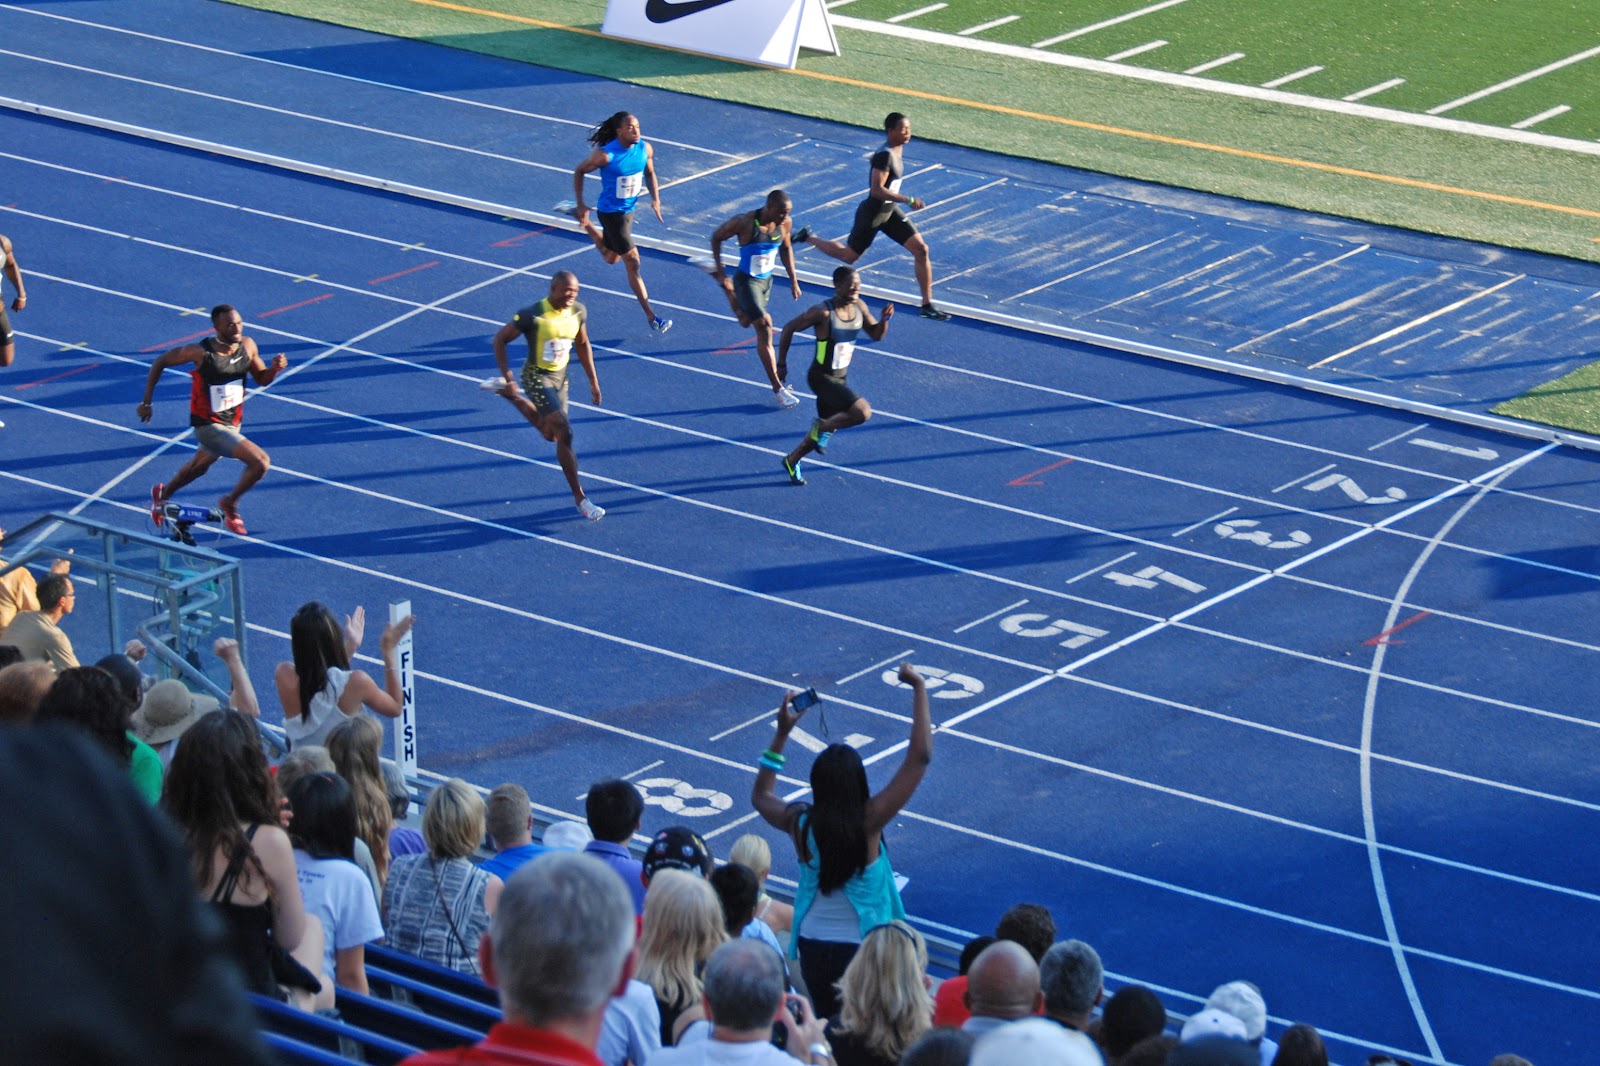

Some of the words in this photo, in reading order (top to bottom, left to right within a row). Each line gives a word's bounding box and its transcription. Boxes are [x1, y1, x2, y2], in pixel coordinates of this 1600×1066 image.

[1408, 438, 1499, 460] 1
[1303, 473, 1407, 505] 2
[1213, 519, 1312, 549] 3
[1102, 565, 1207, 594] 4
[999, 613, 1110, 649] 5
[882, 664, 985, 699] 6
[401, 651, 414, 762] FINISH
[633, 777, 733, 817] 8
